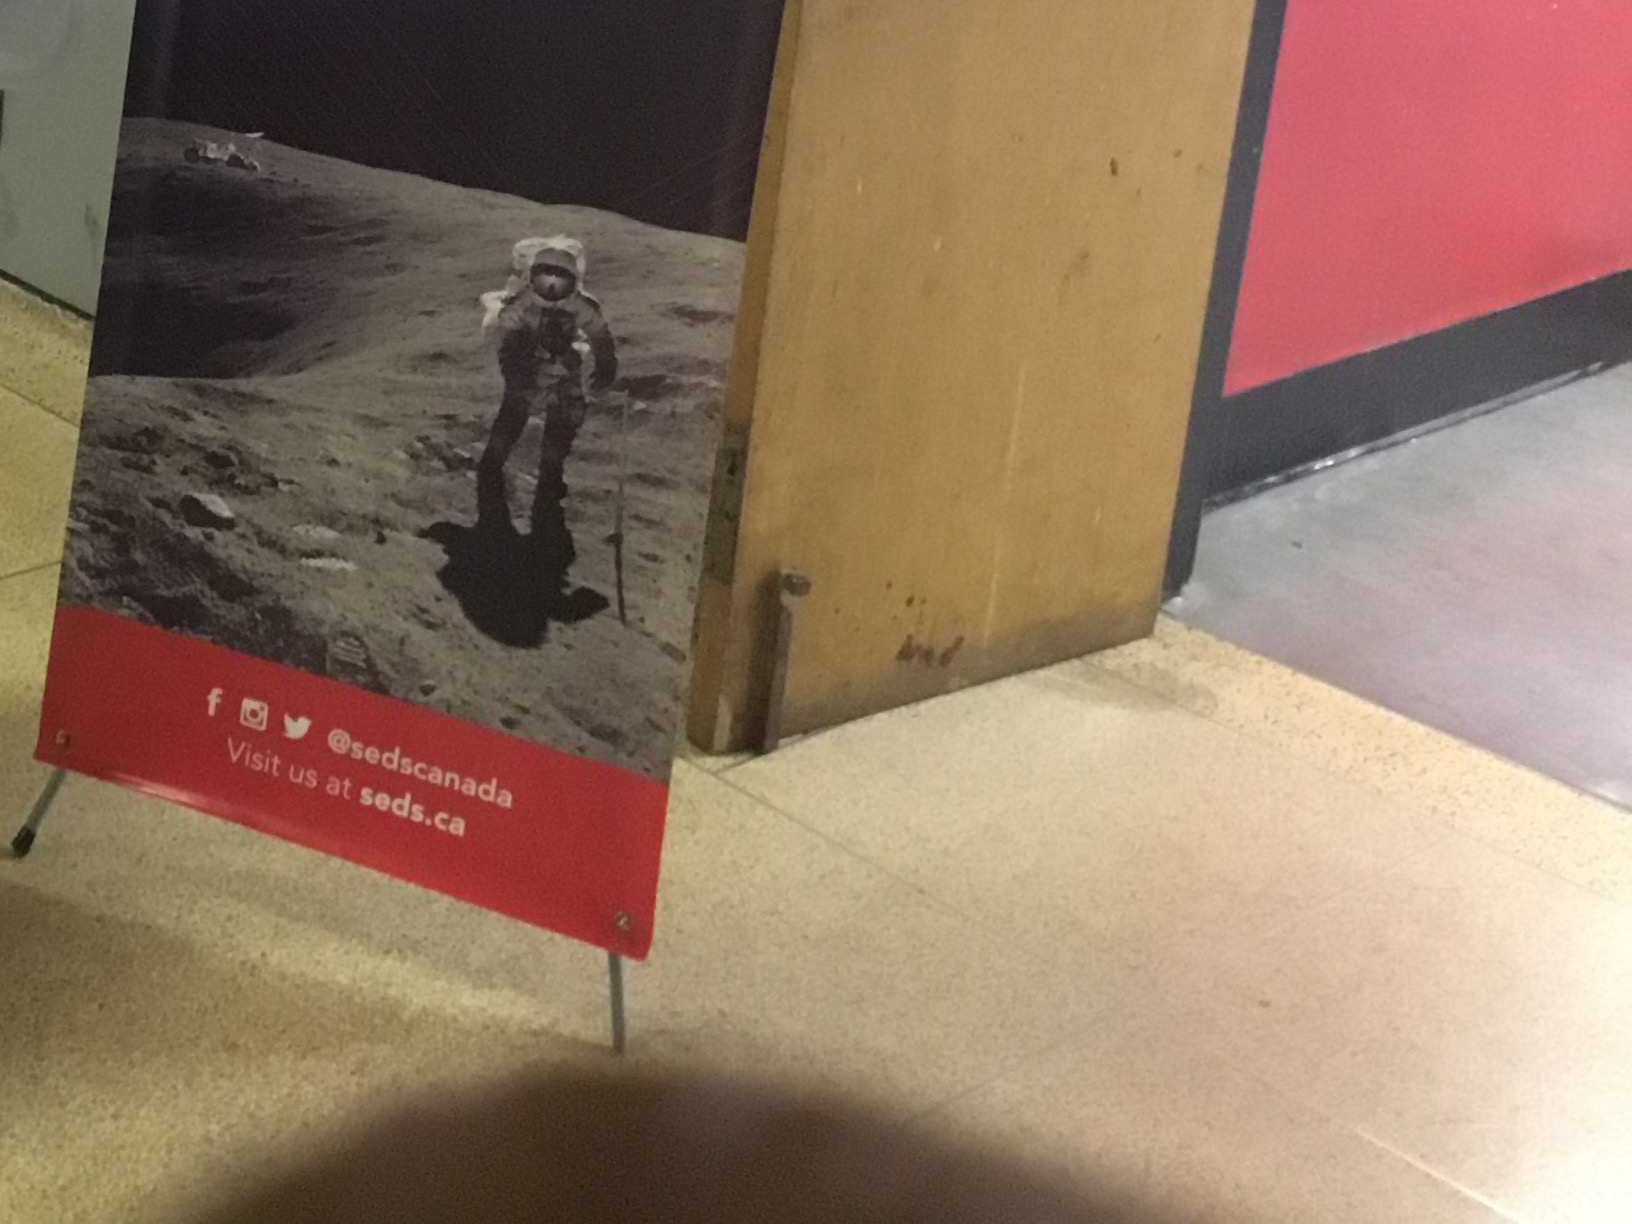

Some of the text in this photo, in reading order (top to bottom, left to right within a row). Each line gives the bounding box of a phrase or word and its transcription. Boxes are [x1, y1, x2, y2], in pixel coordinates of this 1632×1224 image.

[227, 736, 466, 837] Visit us at seds.ca
[327, 728, 513, 809] @sedscanada
